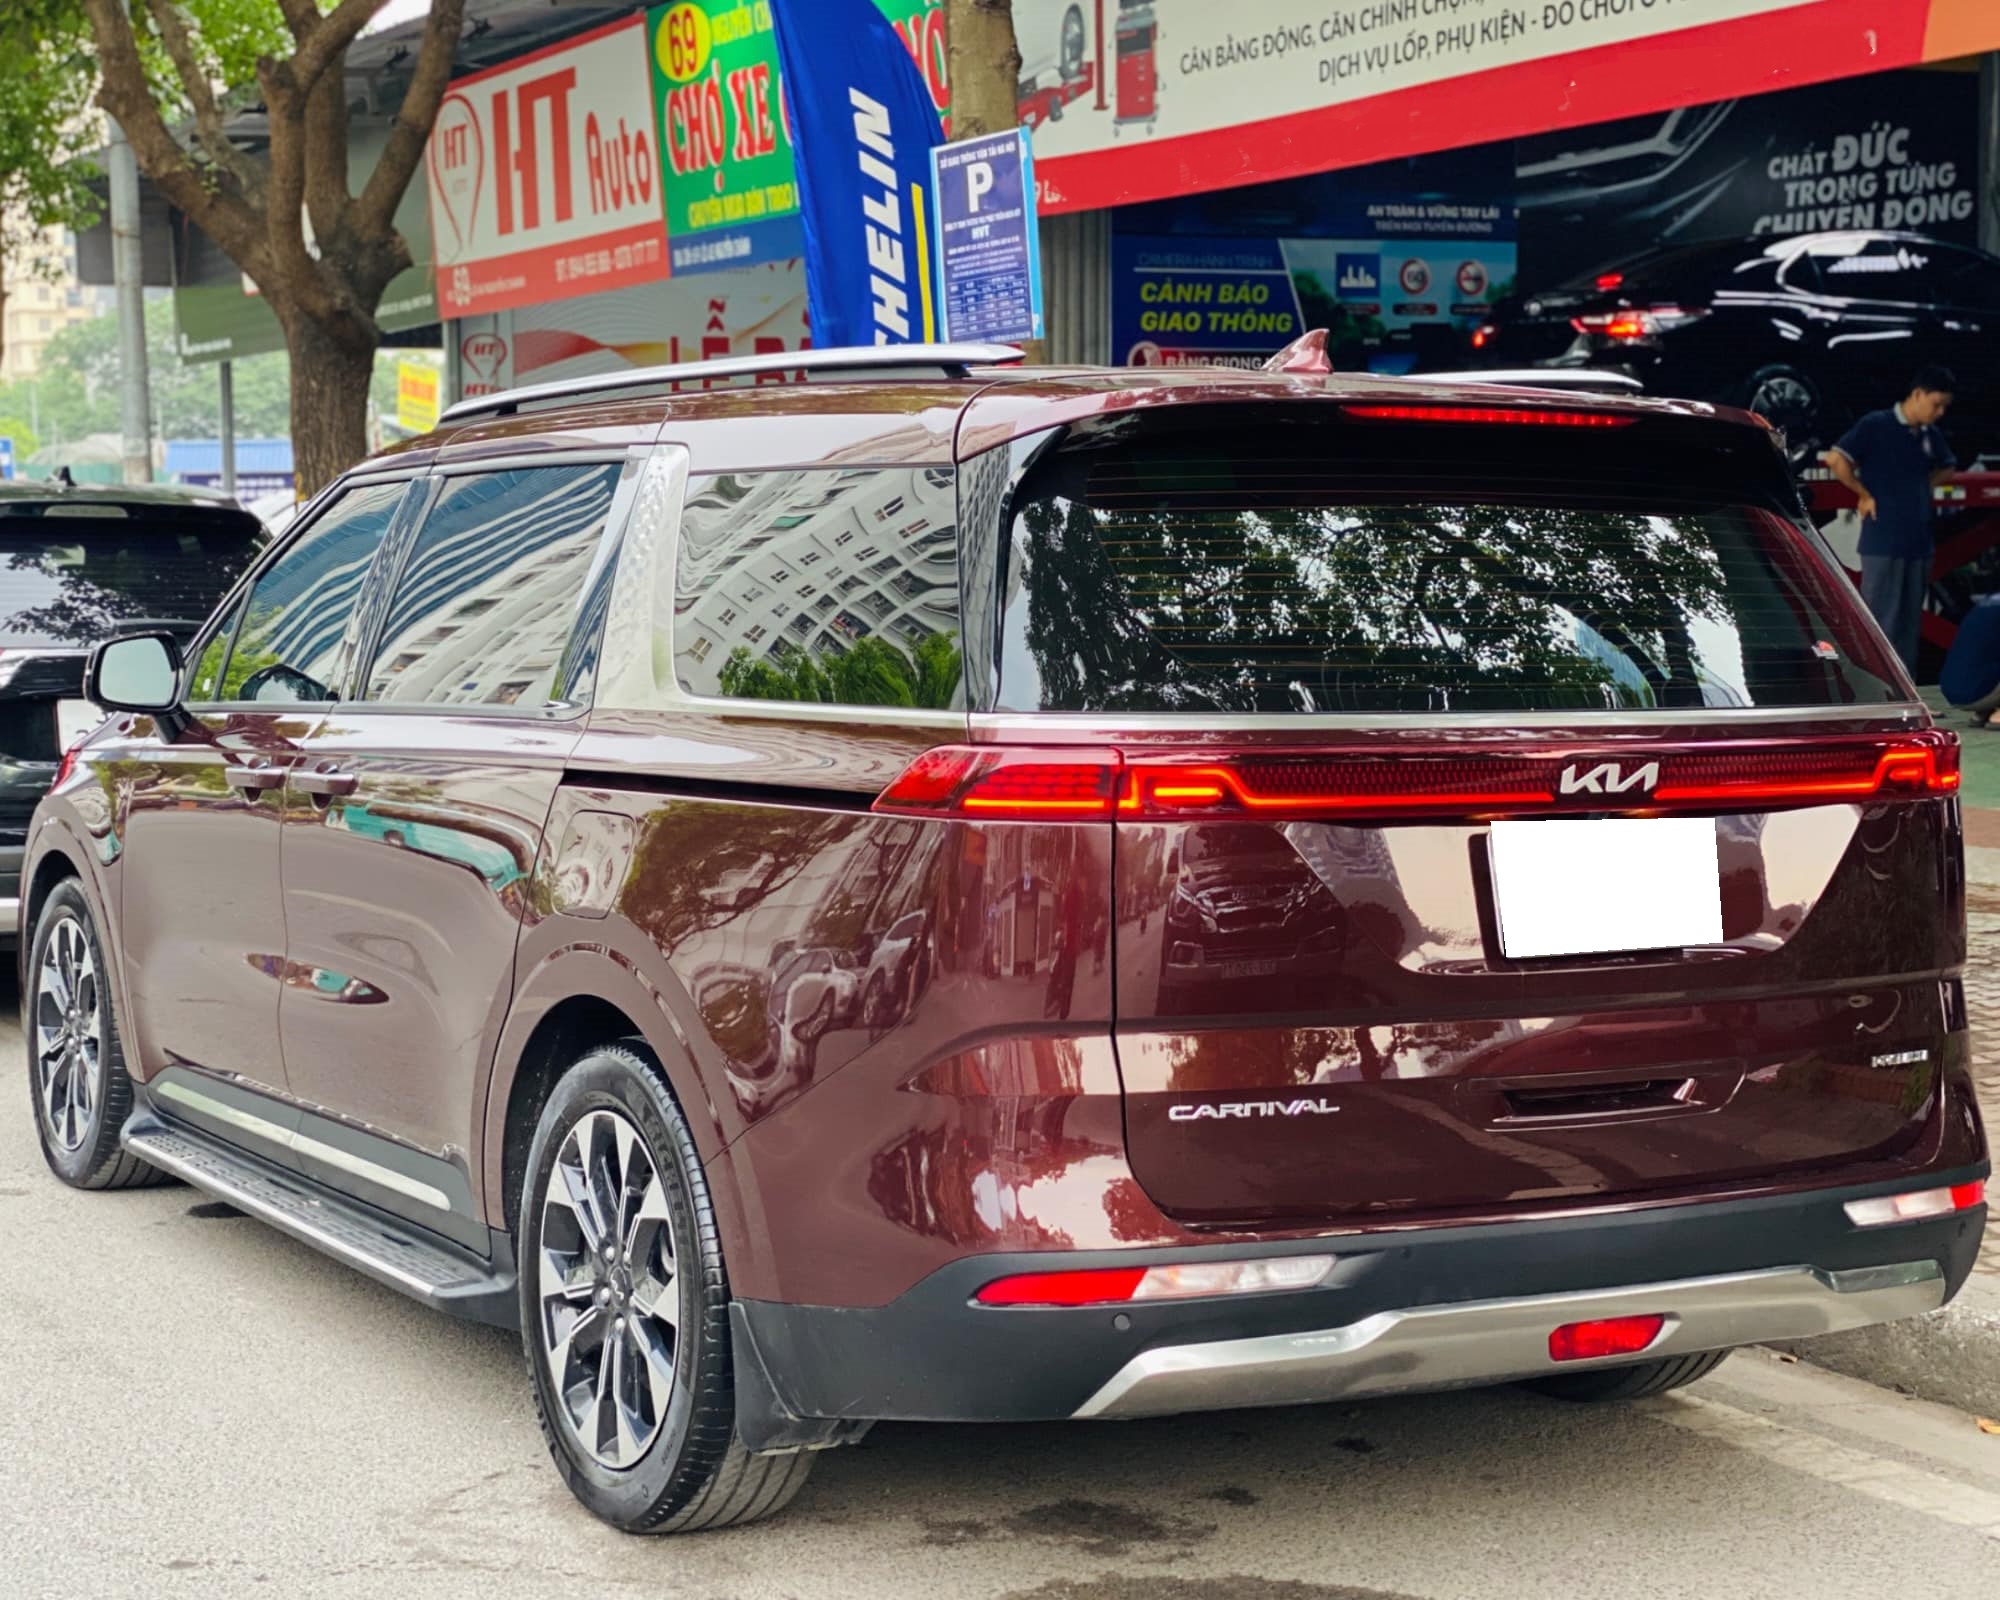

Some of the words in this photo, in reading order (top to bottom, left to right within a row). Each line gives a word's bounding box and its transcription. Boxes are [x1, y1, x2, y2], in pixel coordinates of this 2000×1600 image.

[668, 8, 697, 77] 69
[1319, 51, 1360, 85] DỊCH
[1363, 44, 1389, 74] VỤ
[1436, 22, 1475, 55] PHỤ
[1480, 9, 1525, 46] KIỆN
[727, 61, 775, 161] XE
[492, 66, 577, 236] HT
[585, 111, 651, 215] Auto
[1767, 142, 1828, 179] CHẤT
[1832, 121, 1910, 172] ĐỨC
[966, 162, 994, 213] P
[1784, 172, 1878, 208] TRONG
[1885, 161, 1957, 195] TỪNG
[1218, 279, 1269, 304] BÁO
[1140, 311, 1201, 332] GIAO
[1207, 308, 1293, 332] THÔNG
[1560, 762, 1660, 794] KIA
[1168, 1098, 1340, 1120] CARNIVAL
